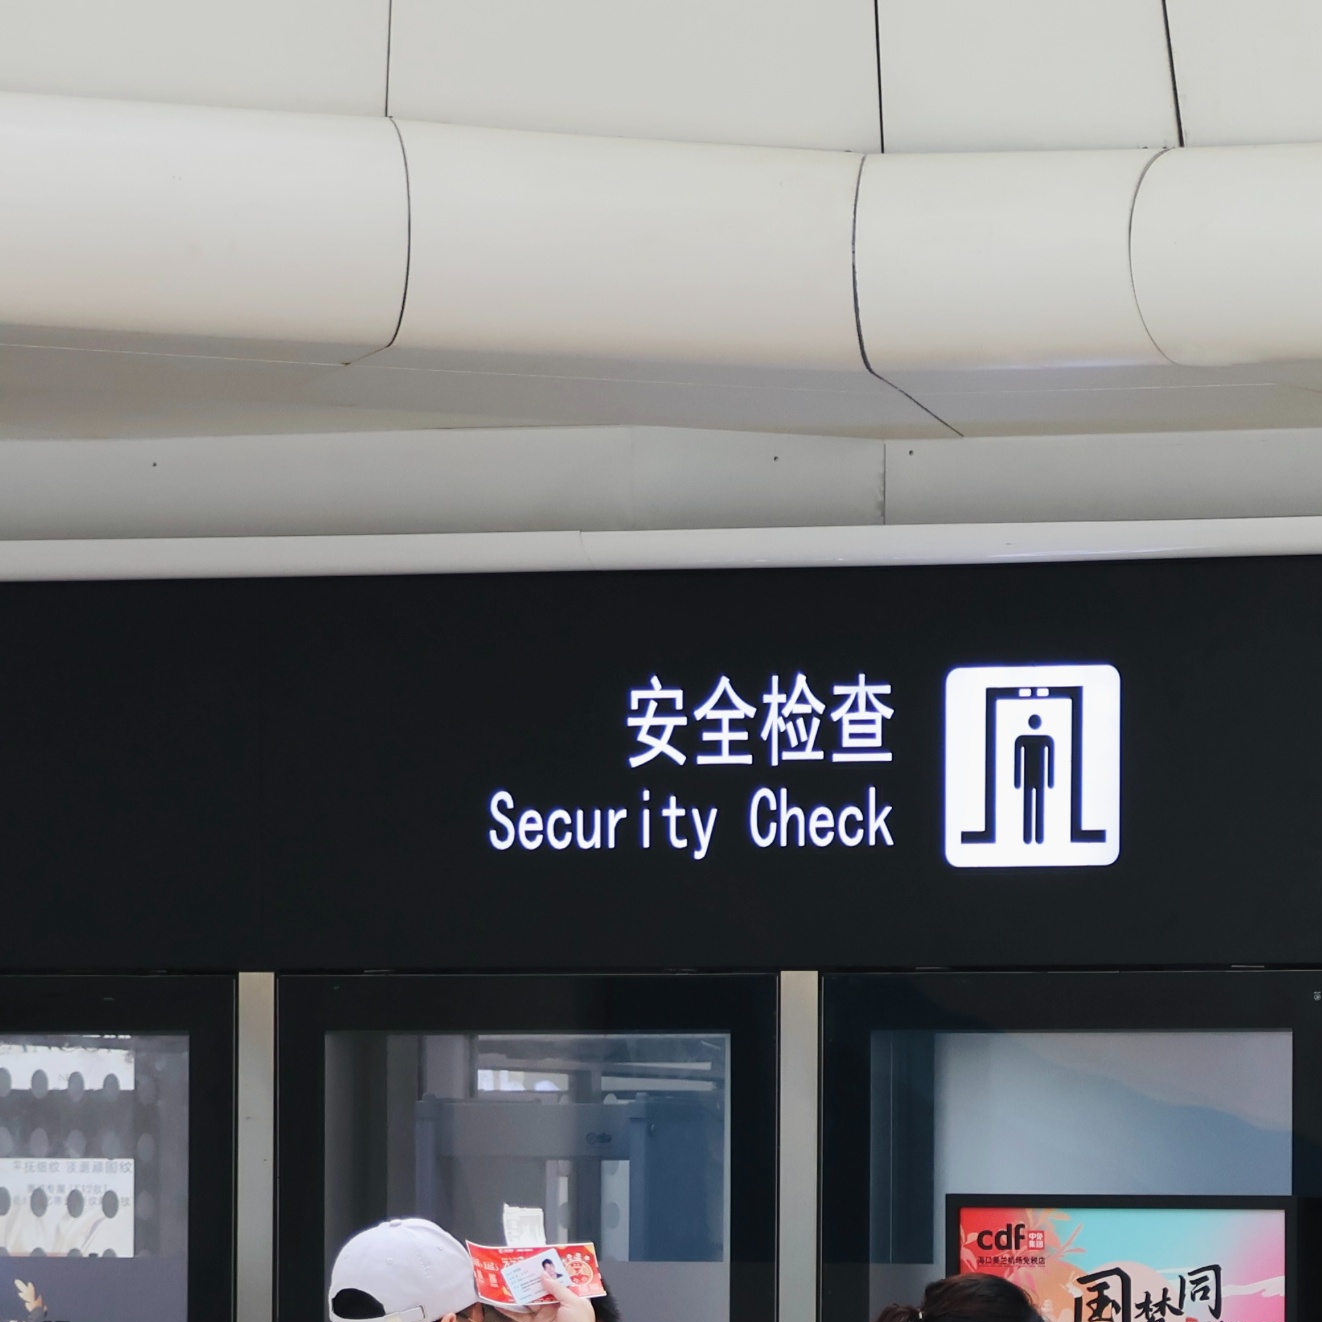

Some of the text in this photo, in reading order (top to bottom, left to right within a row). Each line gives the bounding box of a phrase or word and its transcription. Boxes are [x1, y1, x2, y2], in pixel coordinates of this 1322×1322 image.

[627, 673, 895, 768] 安全检查
[489, 787, 894, 860] Security Check
[977, 1223, 1026, 1250] cdf
